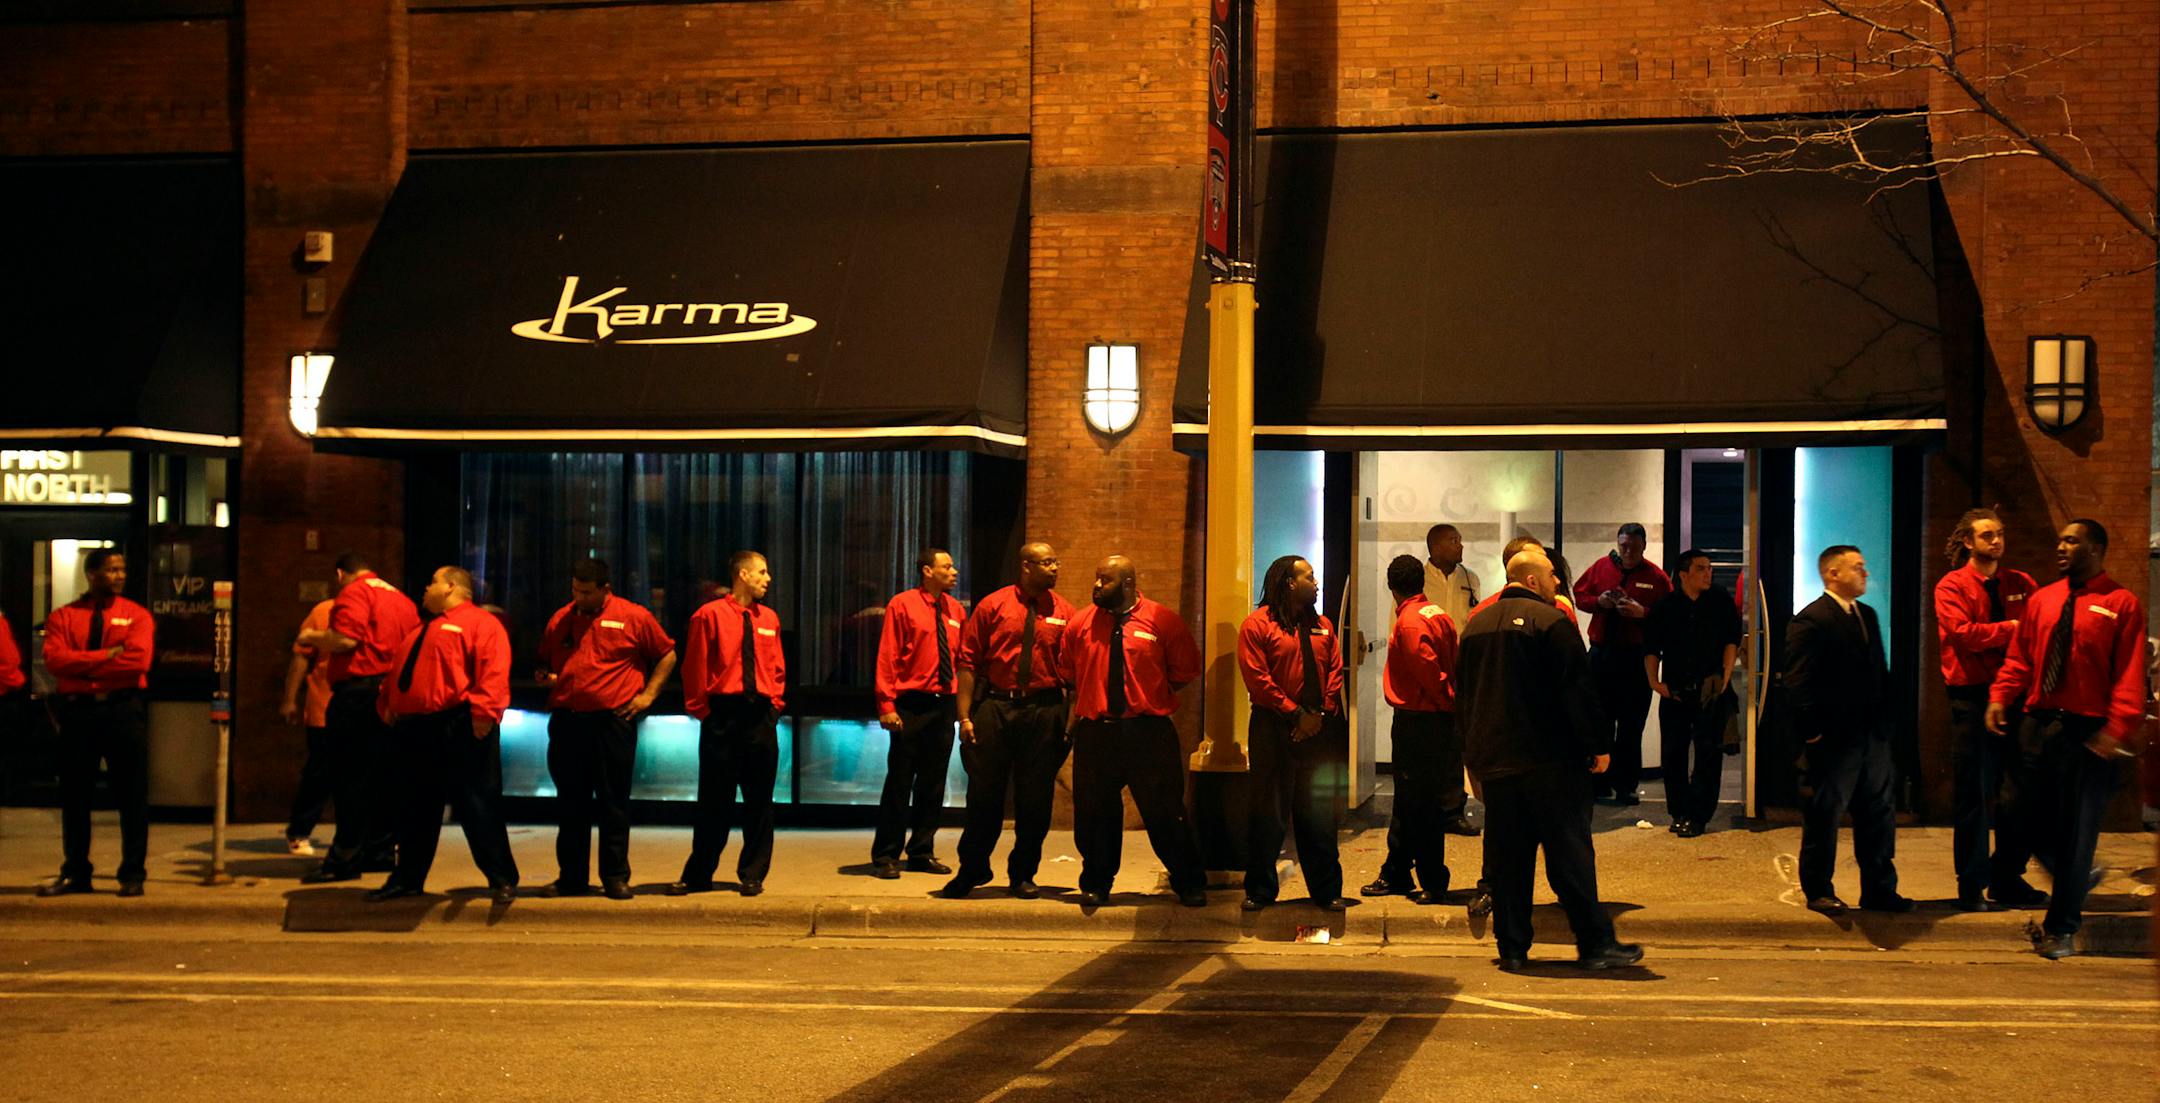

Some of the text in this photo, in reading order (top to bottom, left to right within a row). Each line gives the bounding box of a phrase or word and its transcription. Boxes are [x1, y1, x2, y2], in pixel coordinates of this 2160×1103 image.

[549, 276, 790, 340] Karma
[3, 473, 110, 502] NORTH
[172, 575, 204, 596] VIP
[153, 601, 212, 614] ENTRANC
